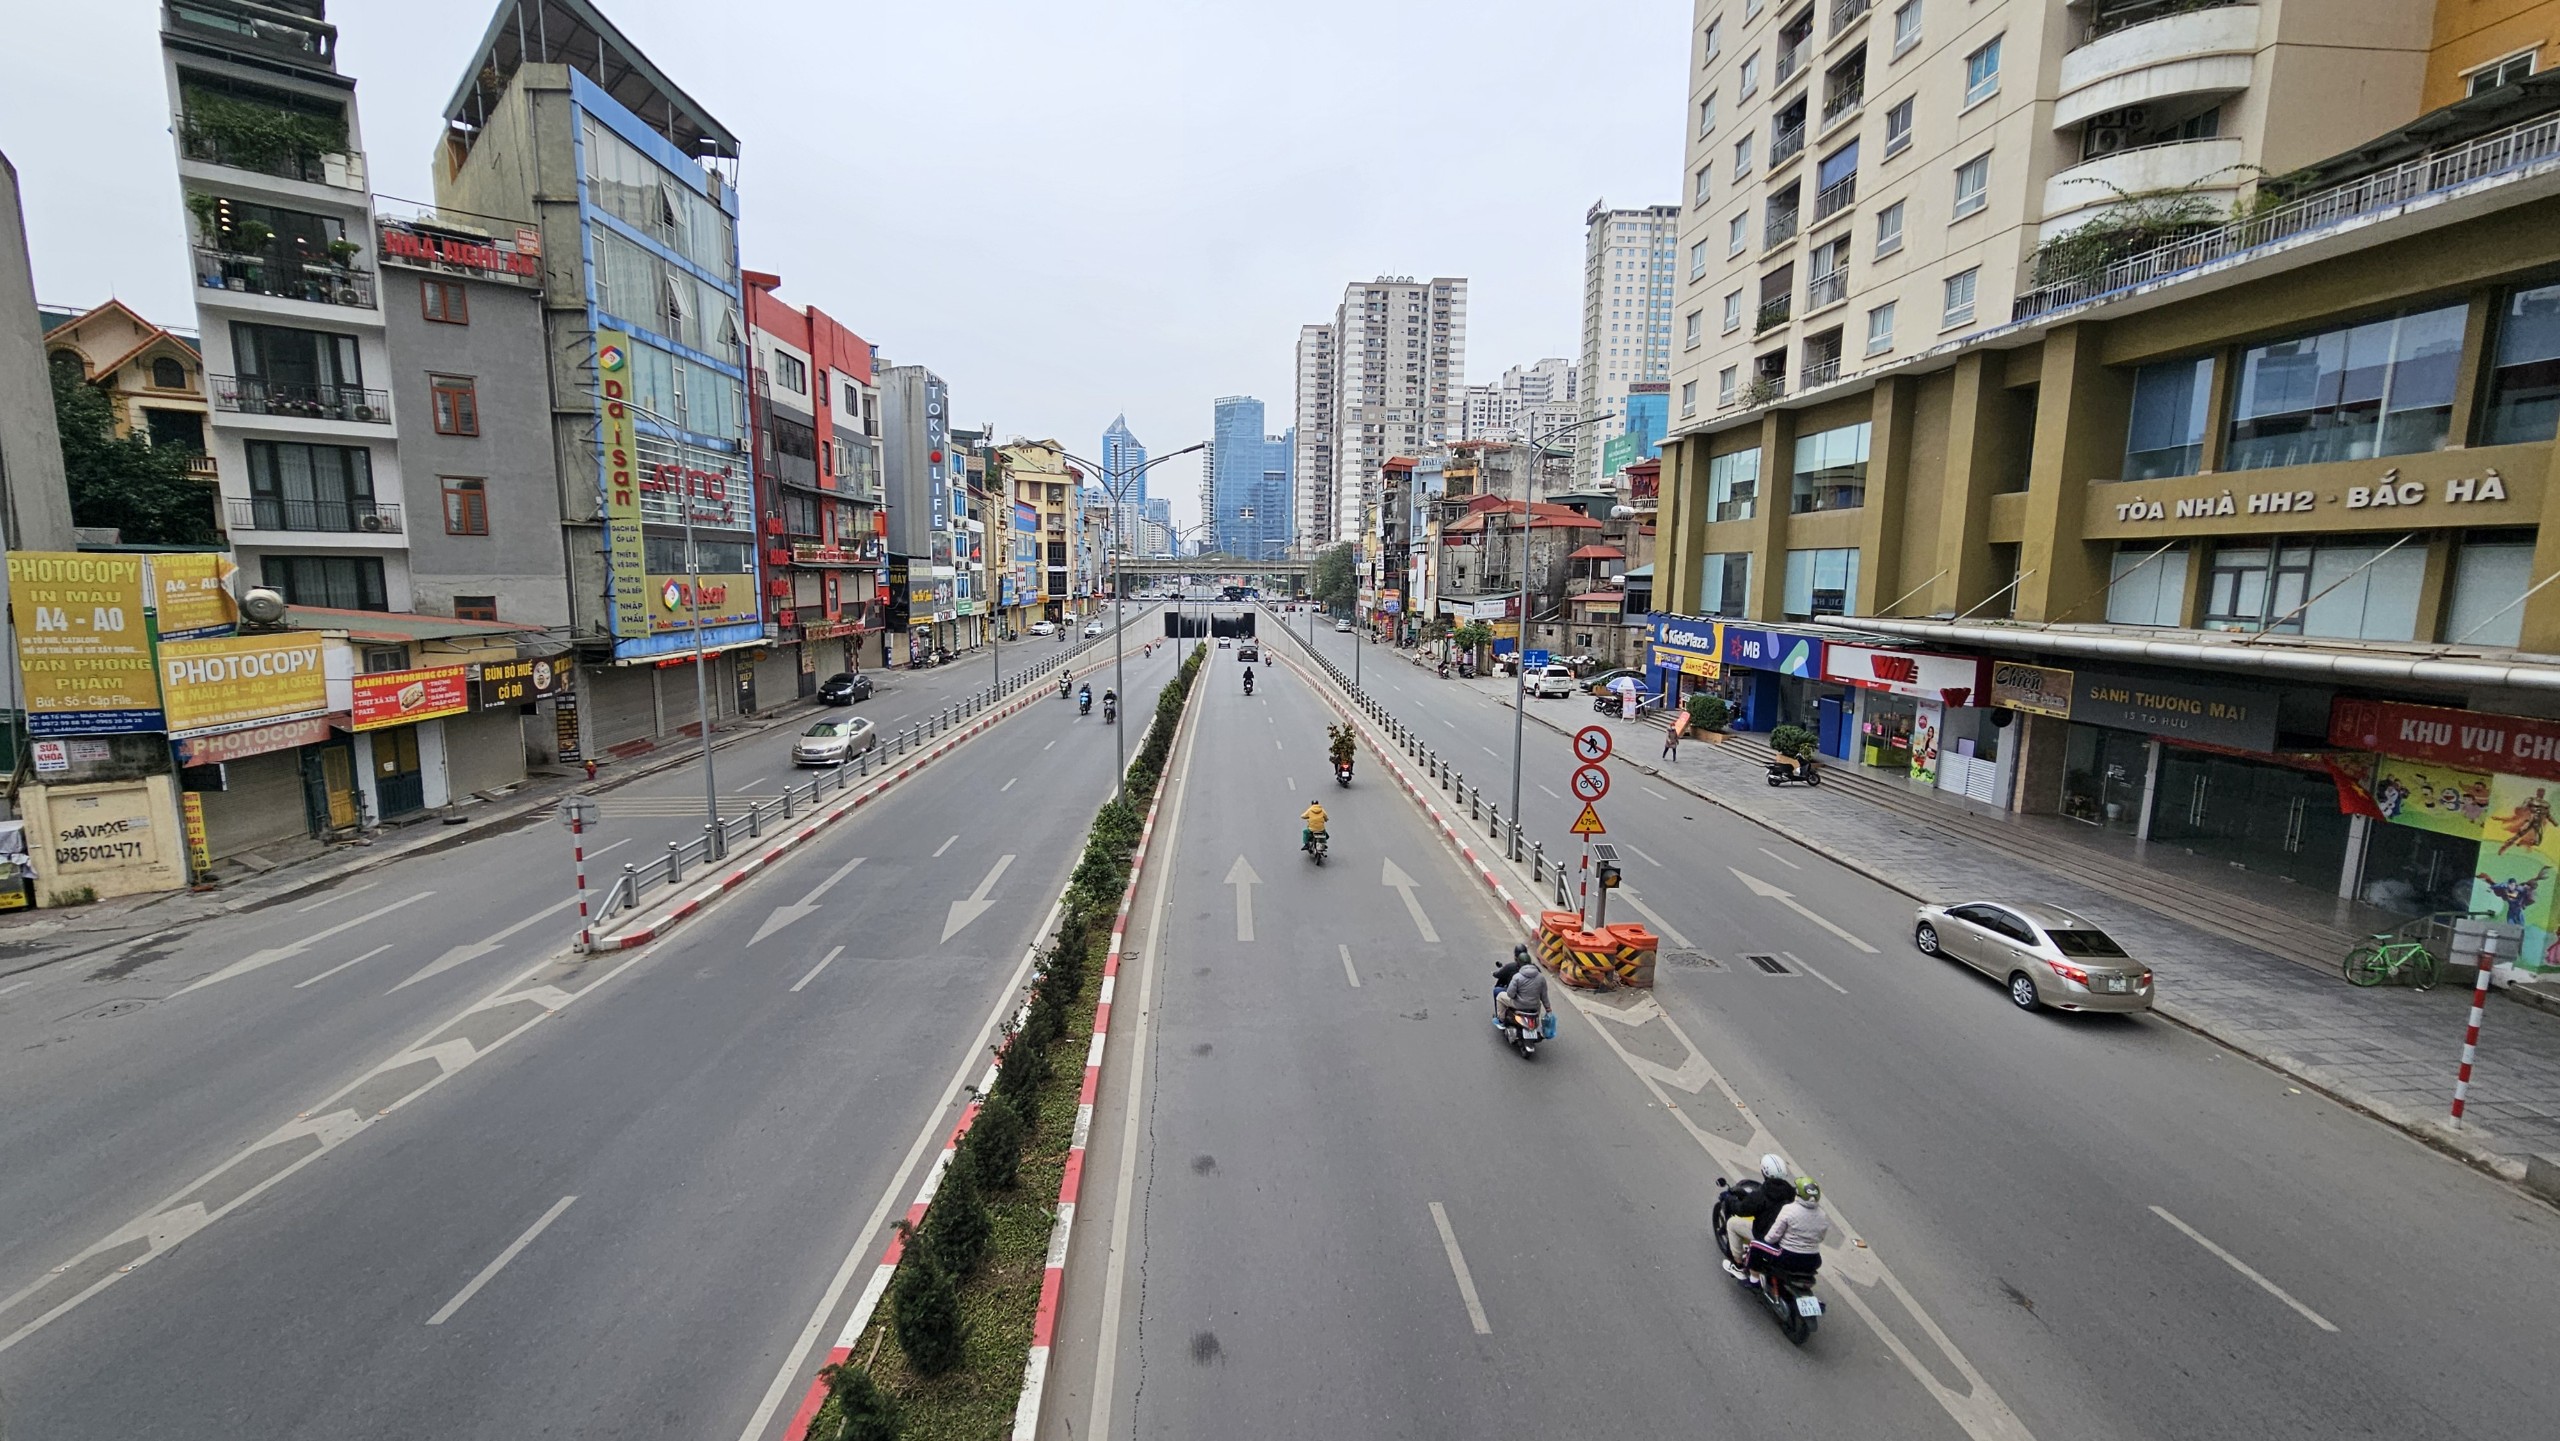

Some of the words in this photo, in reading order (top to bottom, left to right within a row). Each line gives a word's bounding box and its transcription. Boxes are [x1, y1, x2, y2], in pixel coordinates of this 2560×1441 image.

[932, 467, 942, 527] LIFE
[2116, 496, 2165, 521] TÒA
[2176, 489, 2236, 518] NHÀ
[2248, 490, 2315, 514] HH2
[2346, 468, 2426, 508] BẮC
[2445, 468, 2506, 502] HÀ
[6, 558, 136, 584] PHOTOCOPY
[30, 590, 57, 602] IN
[166, 580, 187, 593] A4
[36, 606, 68, 632] A4
[1669, 630, 1708, 649] KidsPlaza
[1743, 640, 1760, 659] MB
[168, 648, 318, 686] PHOTOCOPY
[396, 671, 436, 684] MORNING
[484, 664, 503, 681] BÚN
[504, 662, 516, 678] BÒ
[517, 659, 533, 676] HUẾ
[112, 695, 132, 706] File
[173, 690, 184, 703] IN
[290, 674, 321, 688] OFFSET
[193, 718, 322, 756] PHOTOCOPY
[2400, 718, 2452, 746] KHU
[2461, 726, 2506, 754] VUI
[56, 842, 142, 864] 0385012471
